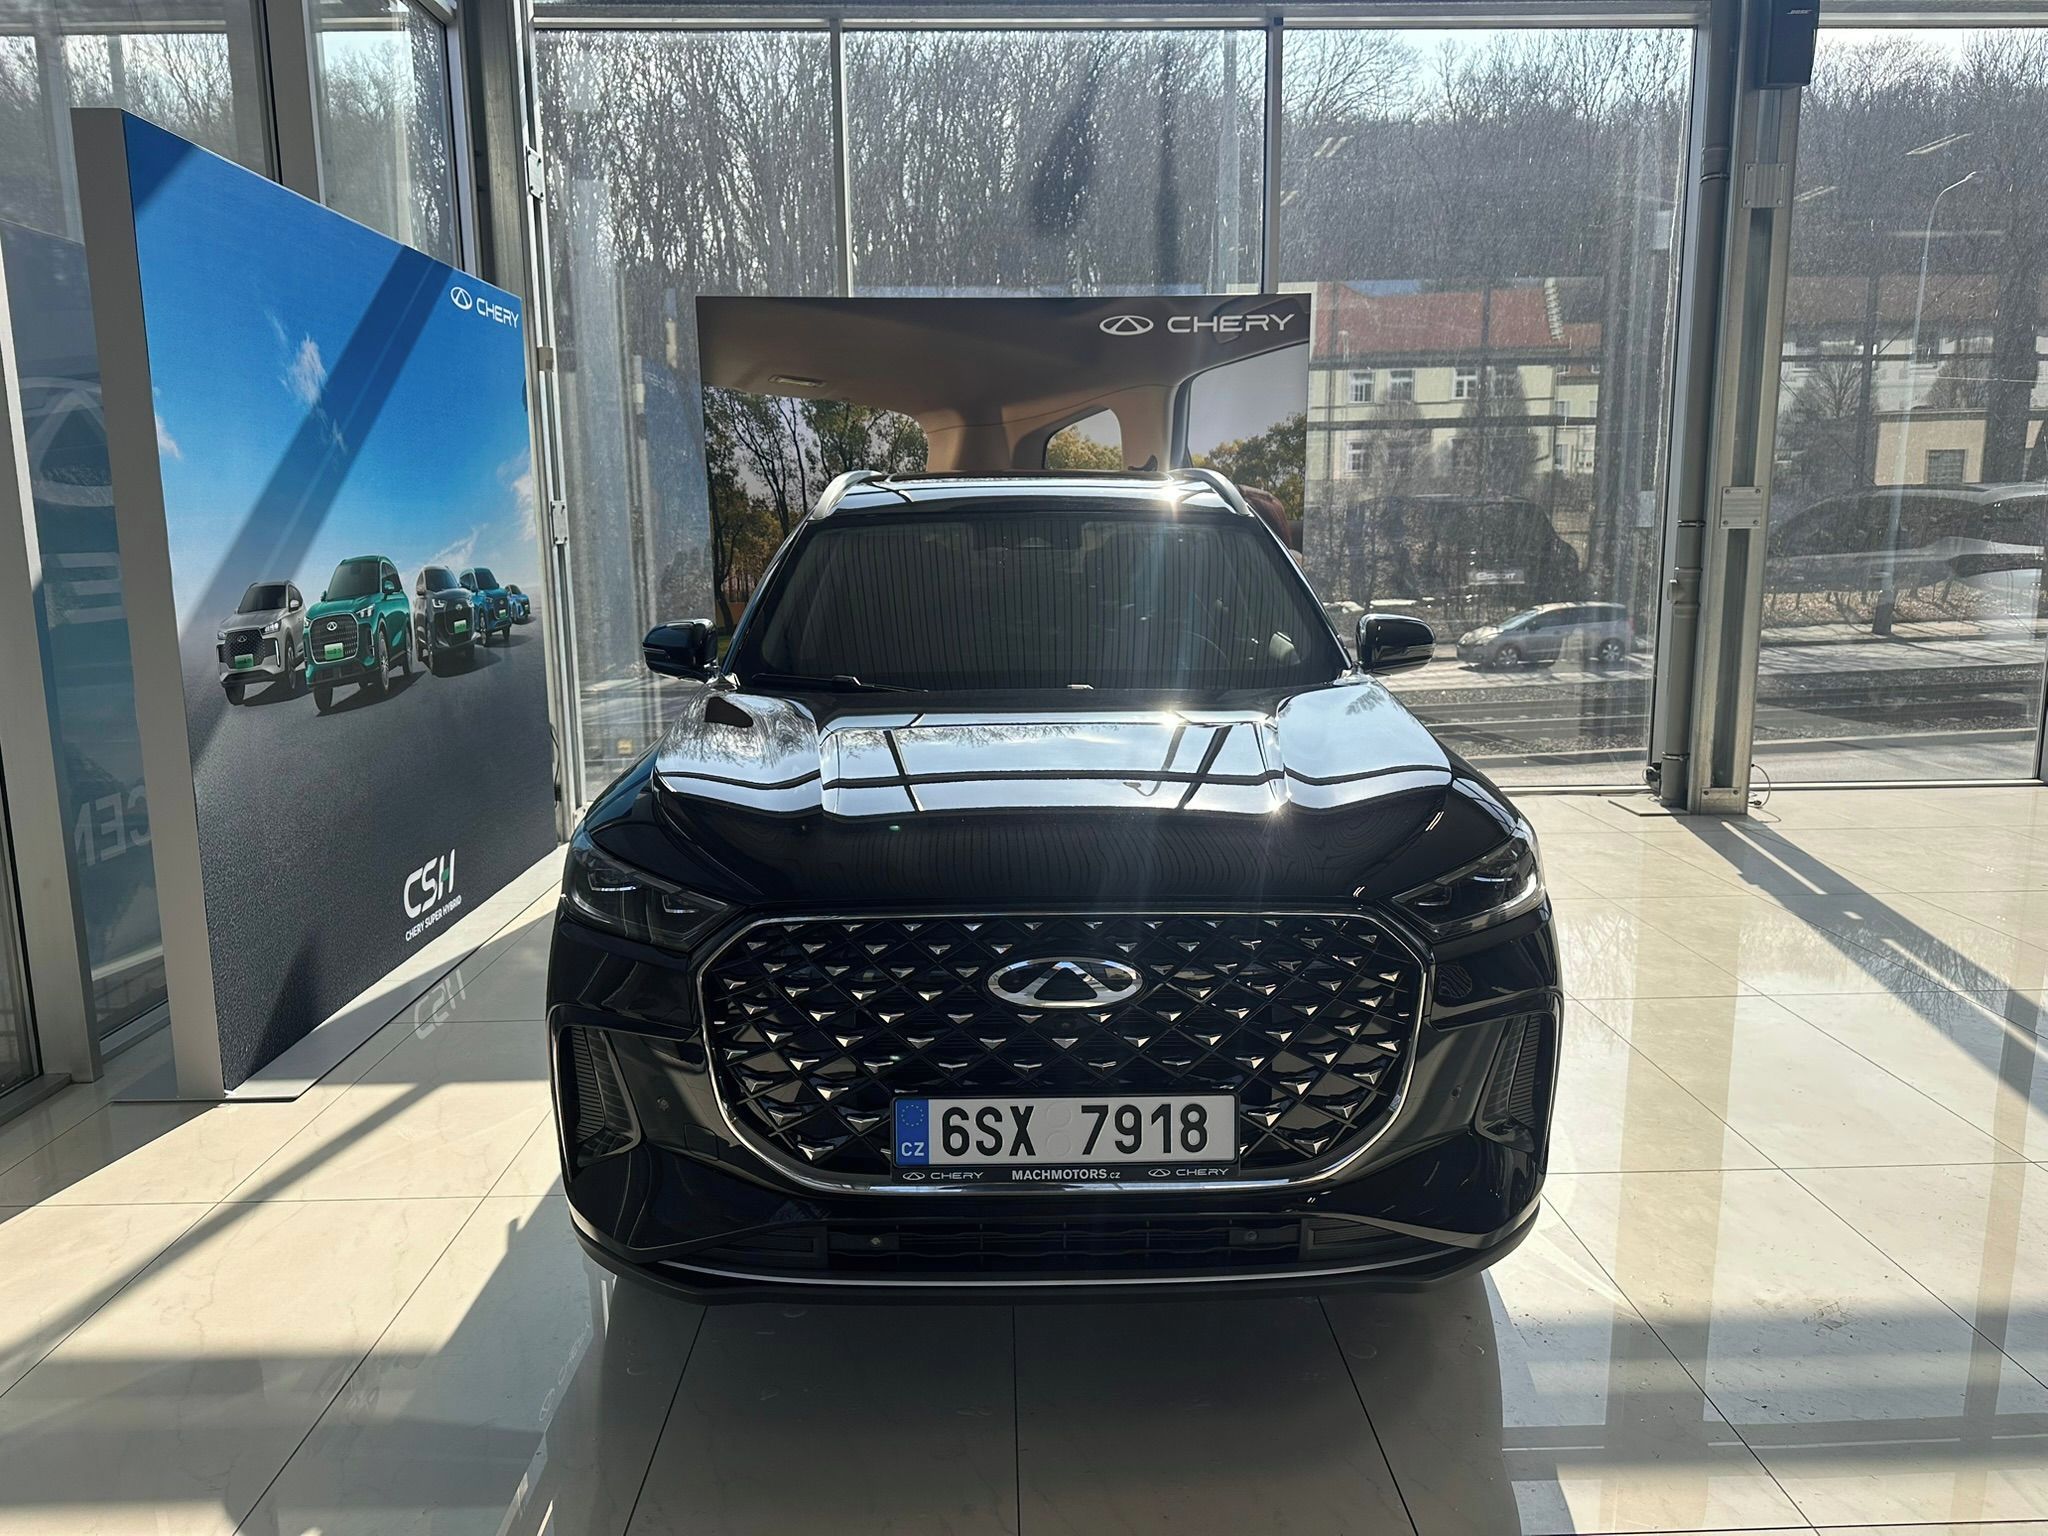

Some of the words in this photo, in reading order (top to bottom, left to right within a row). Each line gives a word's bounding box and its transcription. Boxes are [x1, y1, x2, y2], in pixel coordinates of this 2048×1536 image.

[476, 297, 519, 329] CHERY
[1167, 313, 1296, 333] CHERY
[403, 848, 455, 919] CSH
[405, 920, 425, 941] CHERY
[424, 908, 443, 929] SUPER
[442, 894, 462, 916] HYBRID
[941, 1105, 1037, 1157] 6SX
[1080, 1103, 1209, 1155] 7918
[901, 1142, 925, 1157] CZ
[930, 1171, 984, 1180] CHERY
[1176, 1168, 1229, 1176] CHERY
